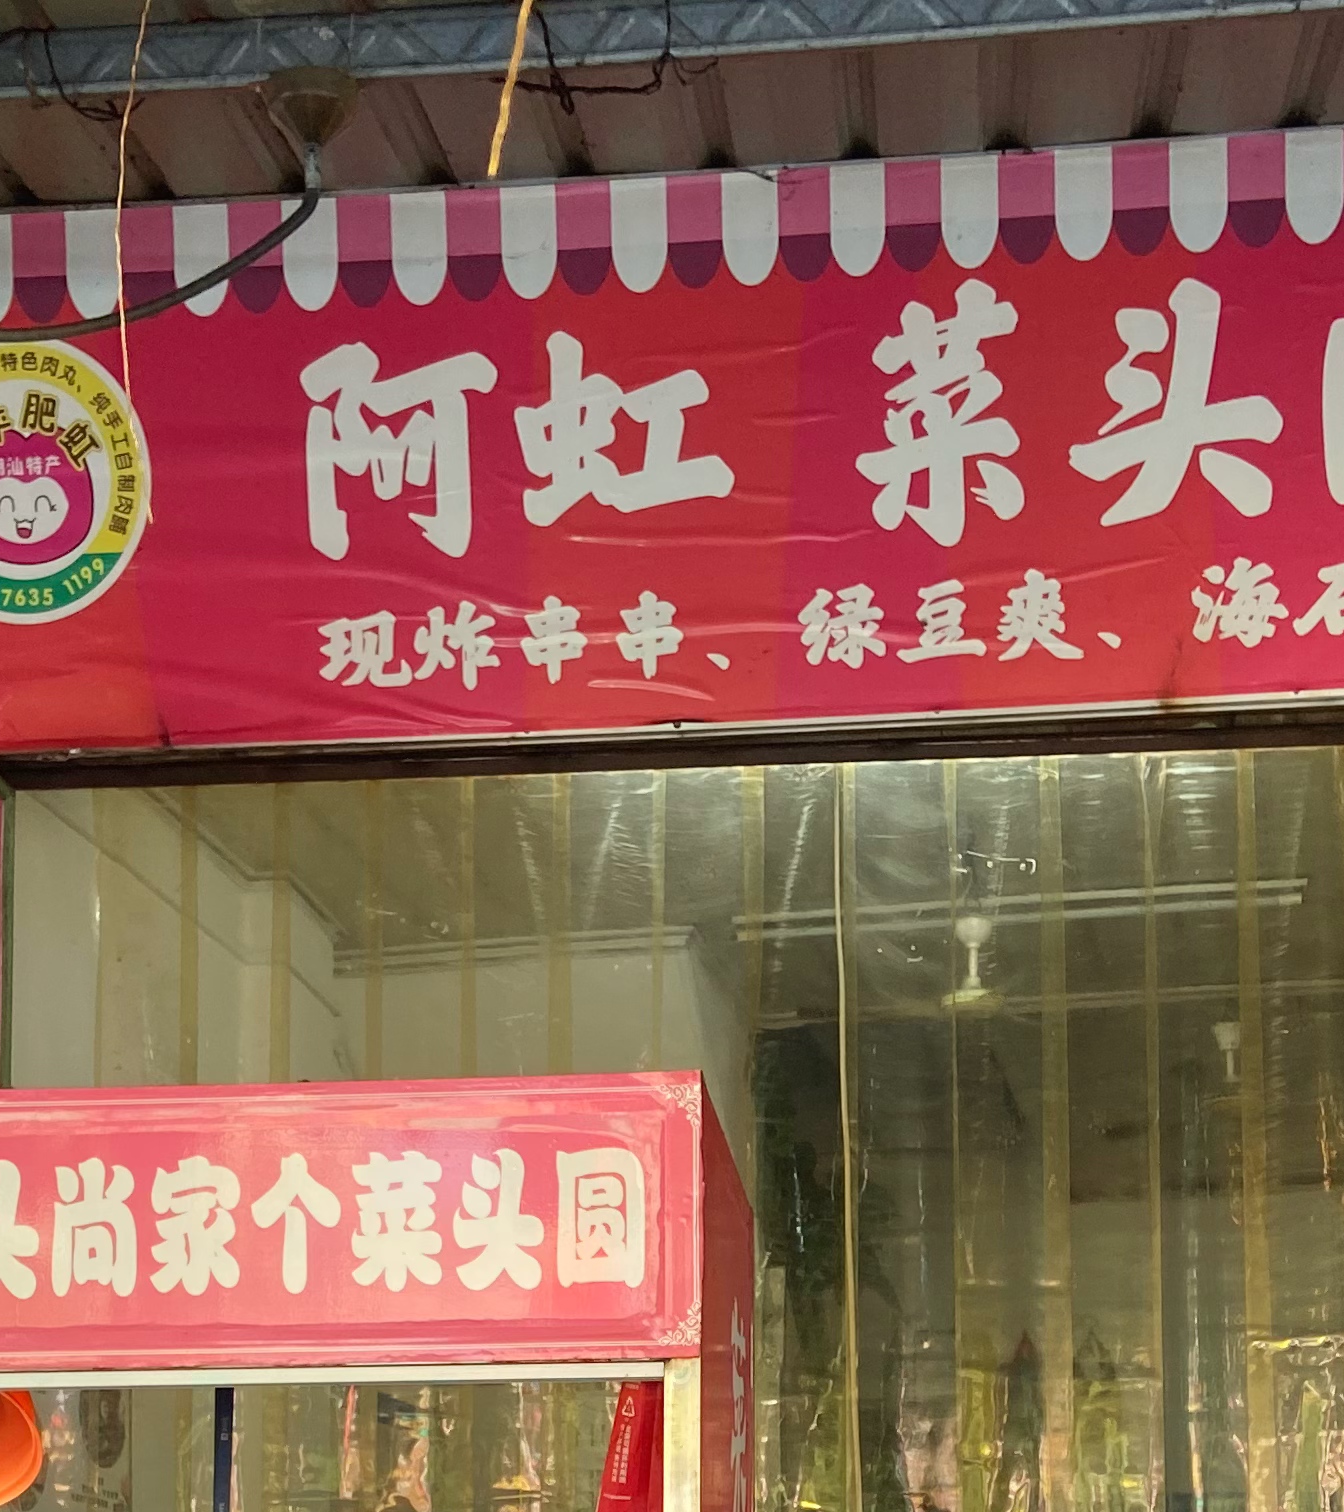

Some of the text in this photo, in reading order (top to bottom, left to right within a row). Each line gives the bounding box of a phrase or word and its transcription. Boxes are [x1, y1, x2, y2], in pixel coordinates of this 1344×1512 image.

[299, 330, 736, 561] 阿虹
[1, 587, 55, 608] 7635
[61, 557, 105, 596] 1199
